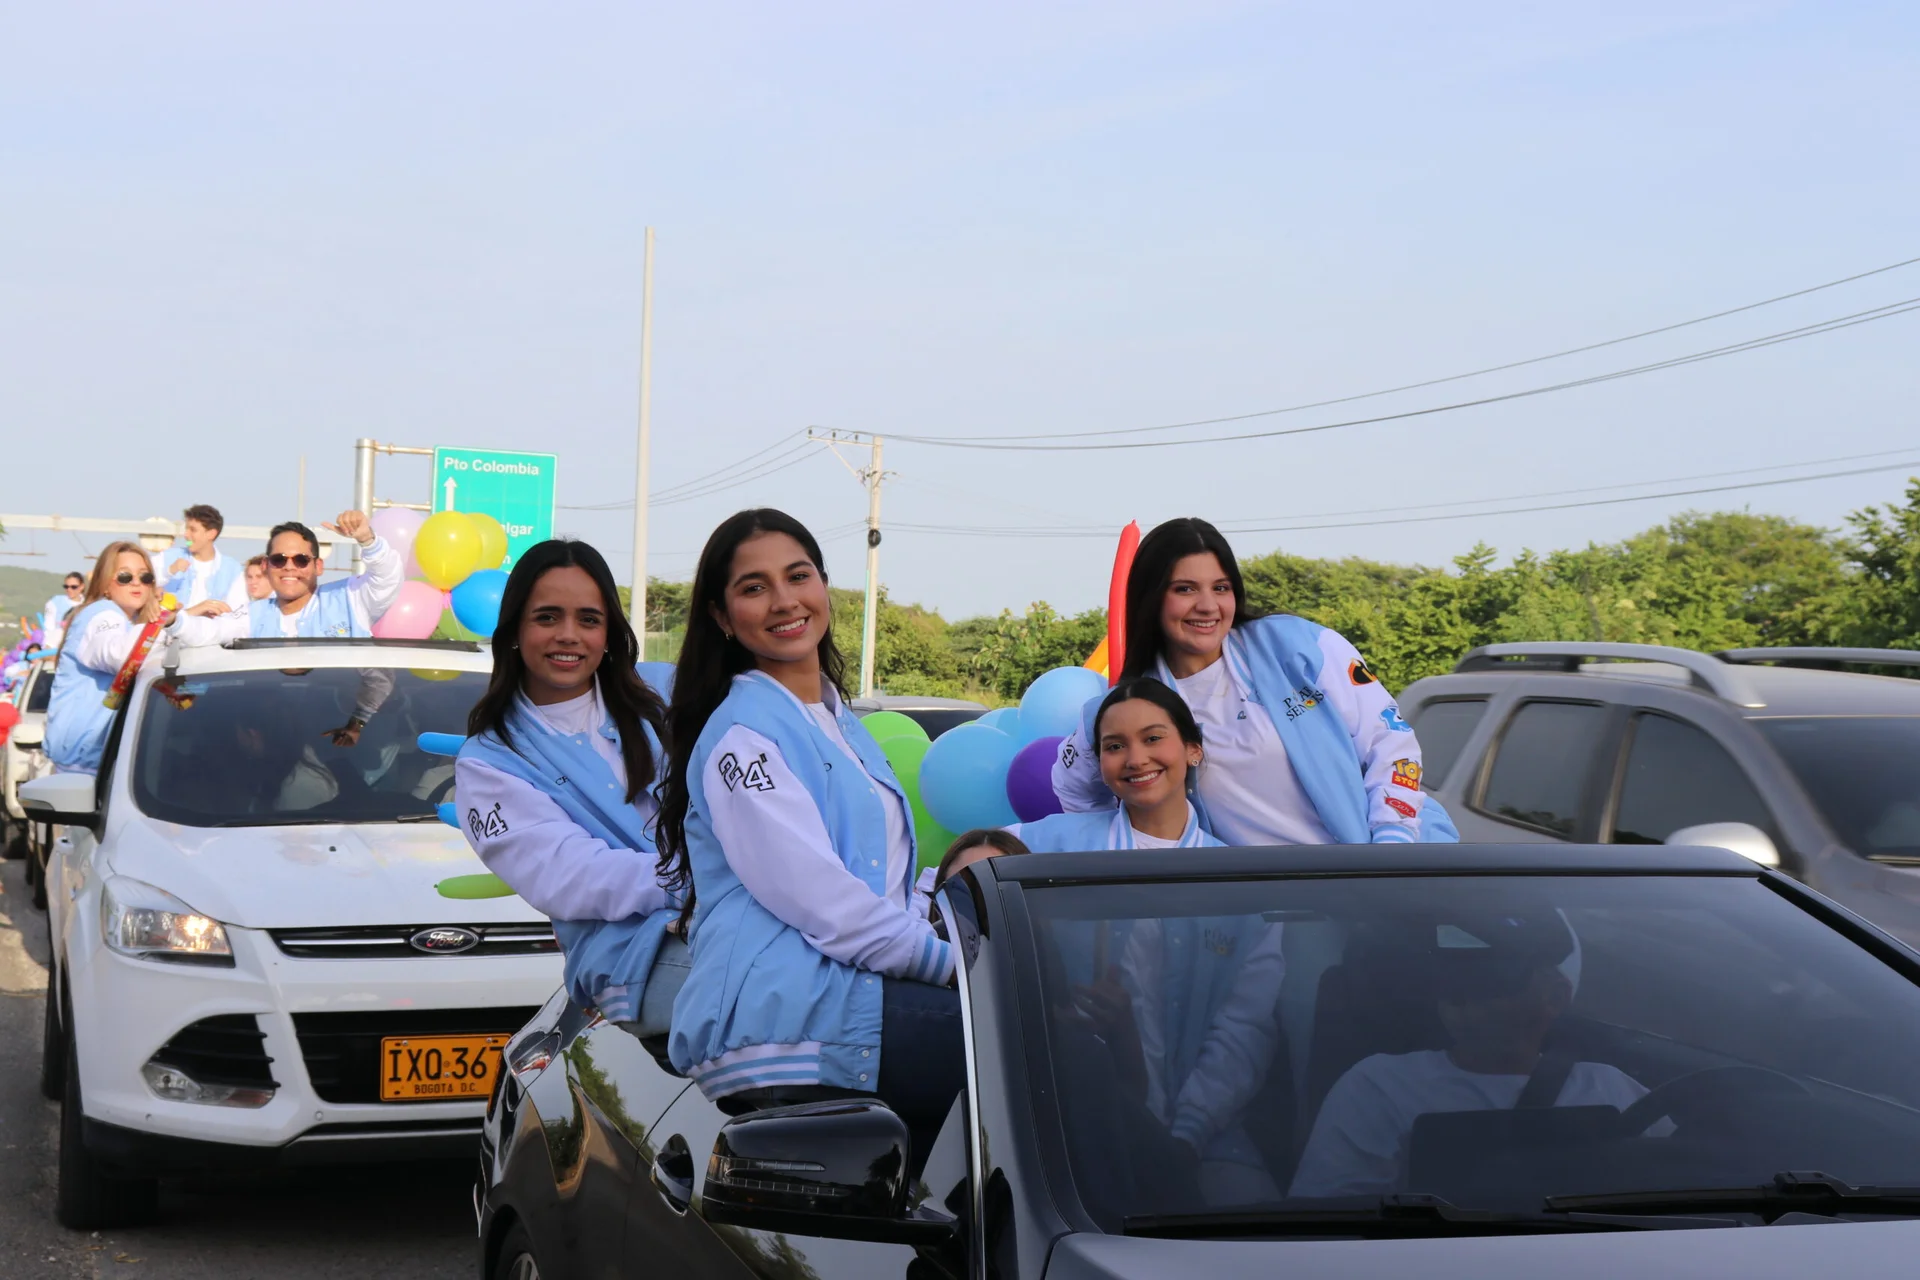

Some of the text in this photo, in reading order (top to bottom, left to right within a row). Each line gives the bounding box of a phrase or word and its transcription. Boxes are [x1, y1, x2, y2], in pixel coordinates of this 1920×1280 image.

[444, 457, 540, 475] Pto Colombia
[1391, 758, 1422, 780] TO
[426, 931, 465, 948] Ford
[414, 1083, 454, 1094] BOGOTA
